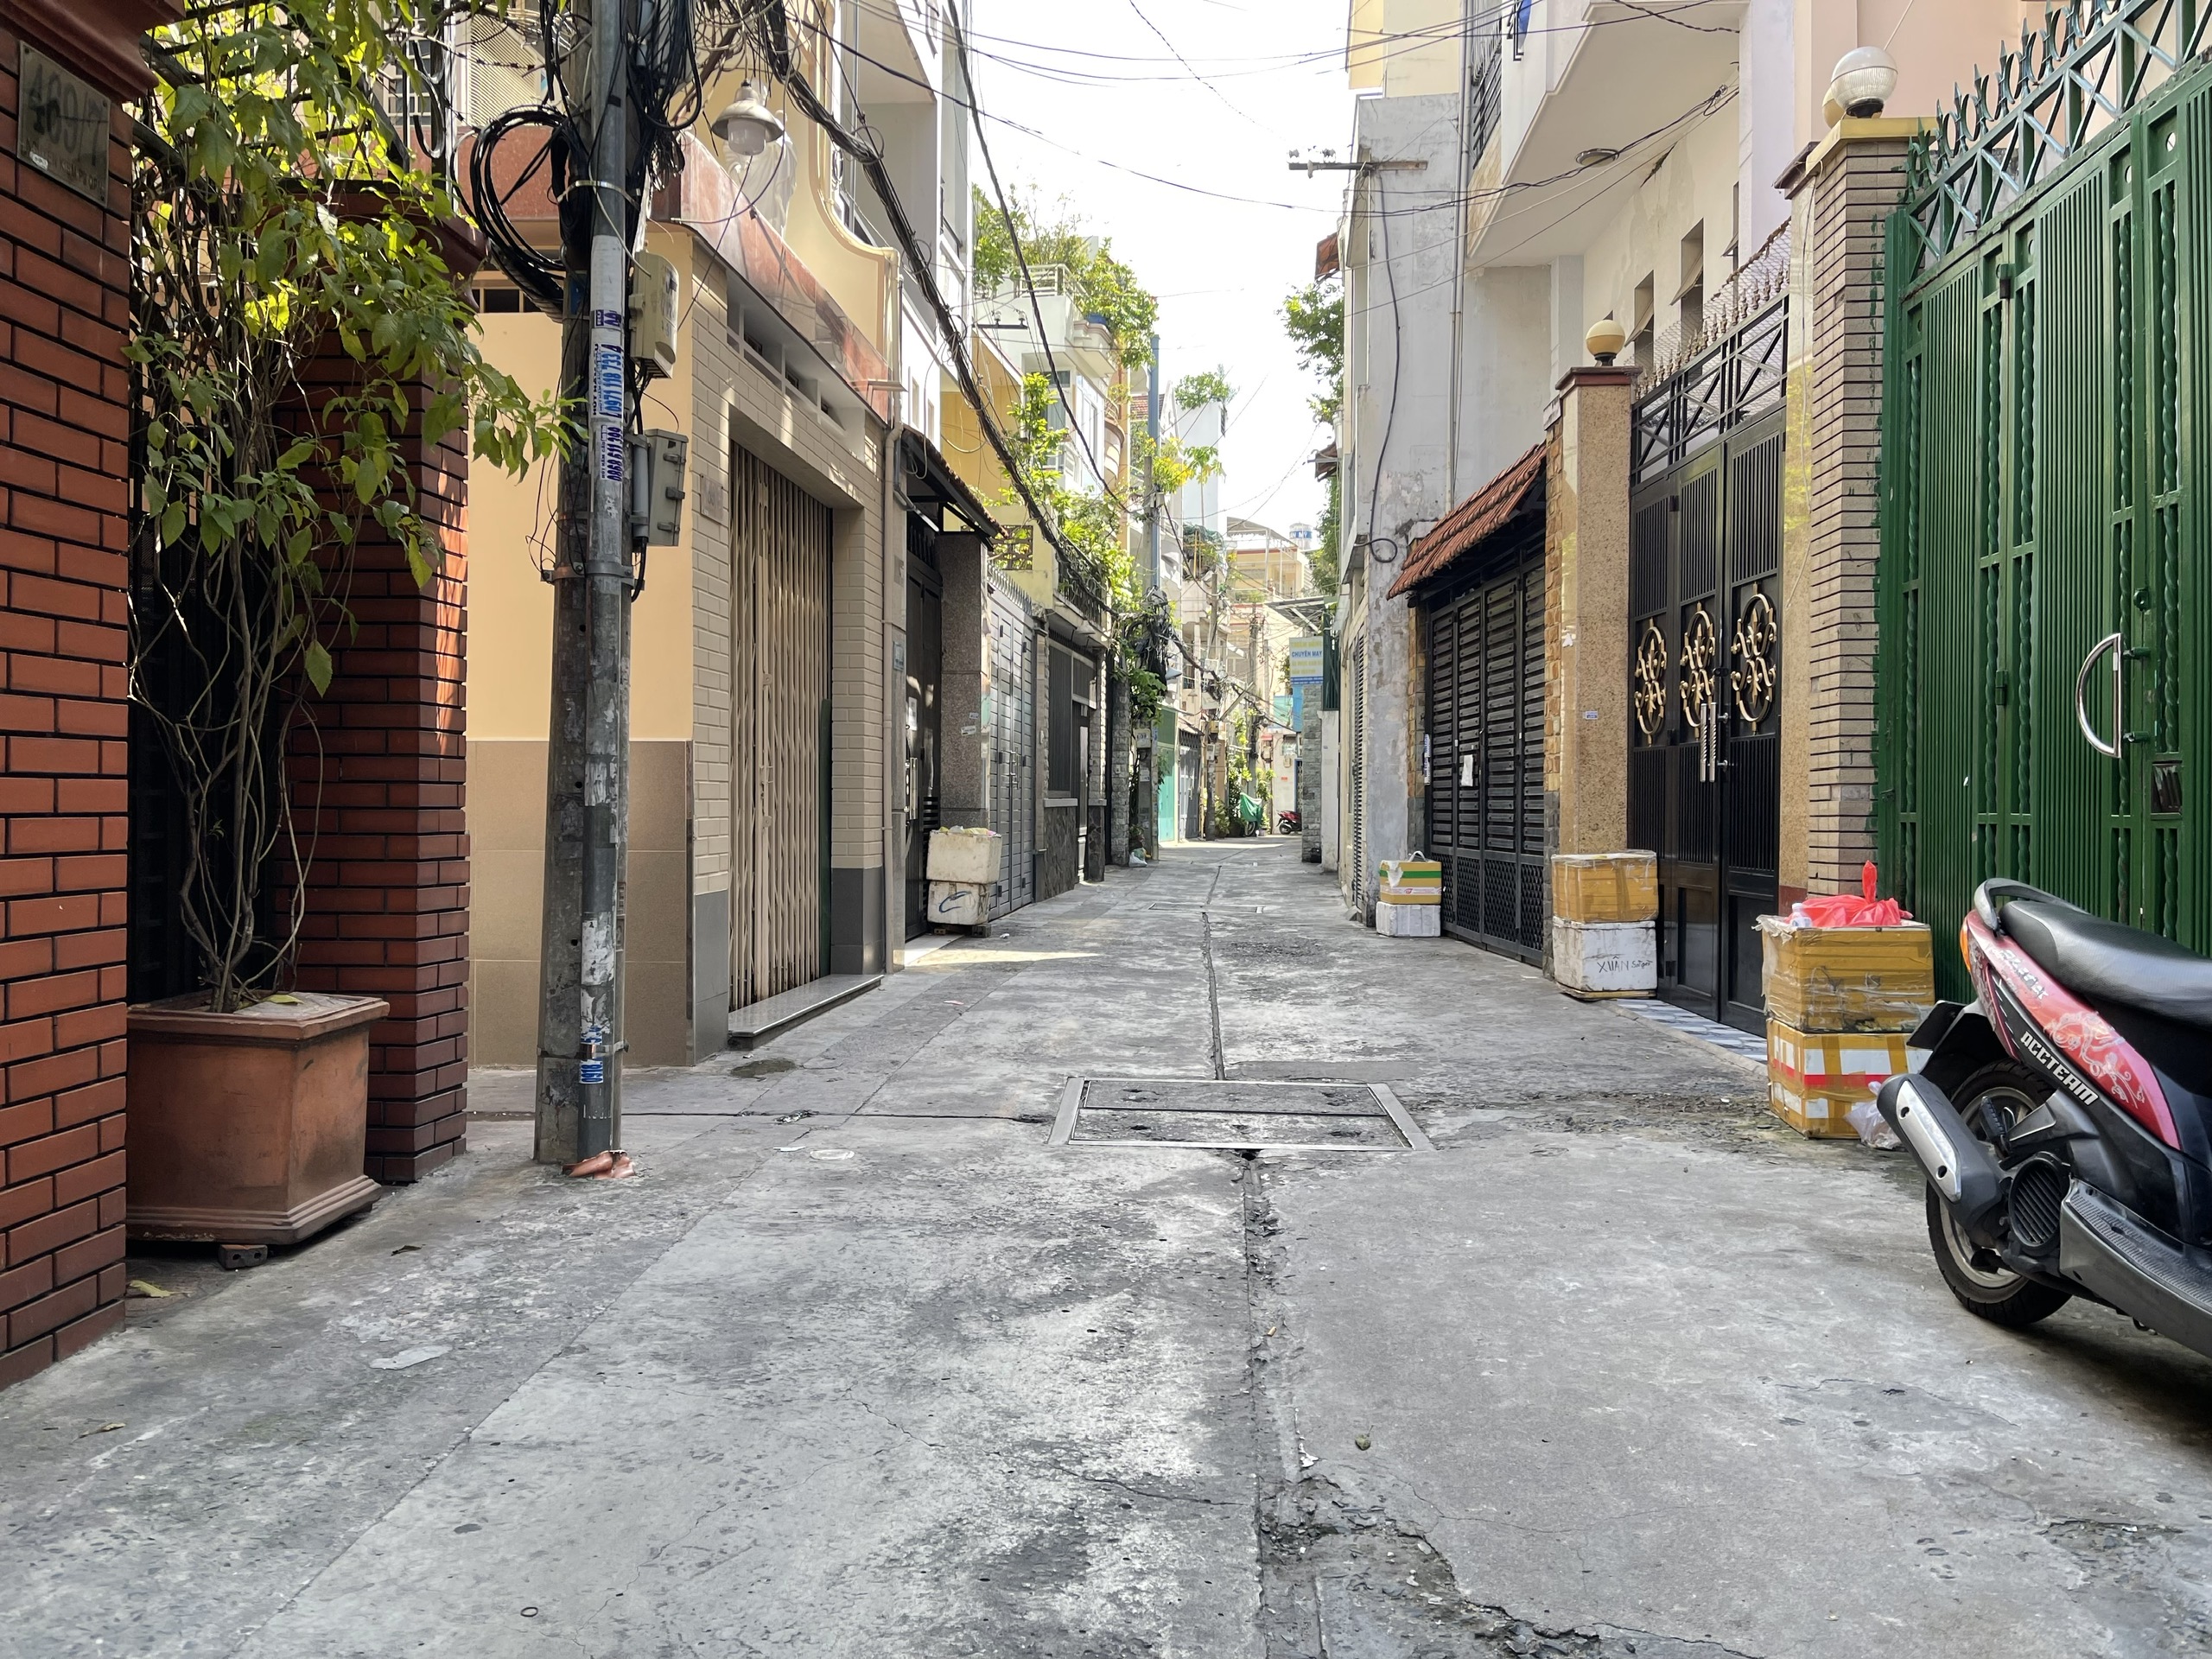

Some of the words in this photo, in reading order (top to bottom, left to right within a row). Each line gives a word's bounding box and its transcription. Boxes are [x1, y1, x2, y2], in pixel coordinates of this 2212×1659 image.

[601, 353, 621, 371] 733
[602, 372, 622, 388] 118
[603, 390, 622, 412] 0971
